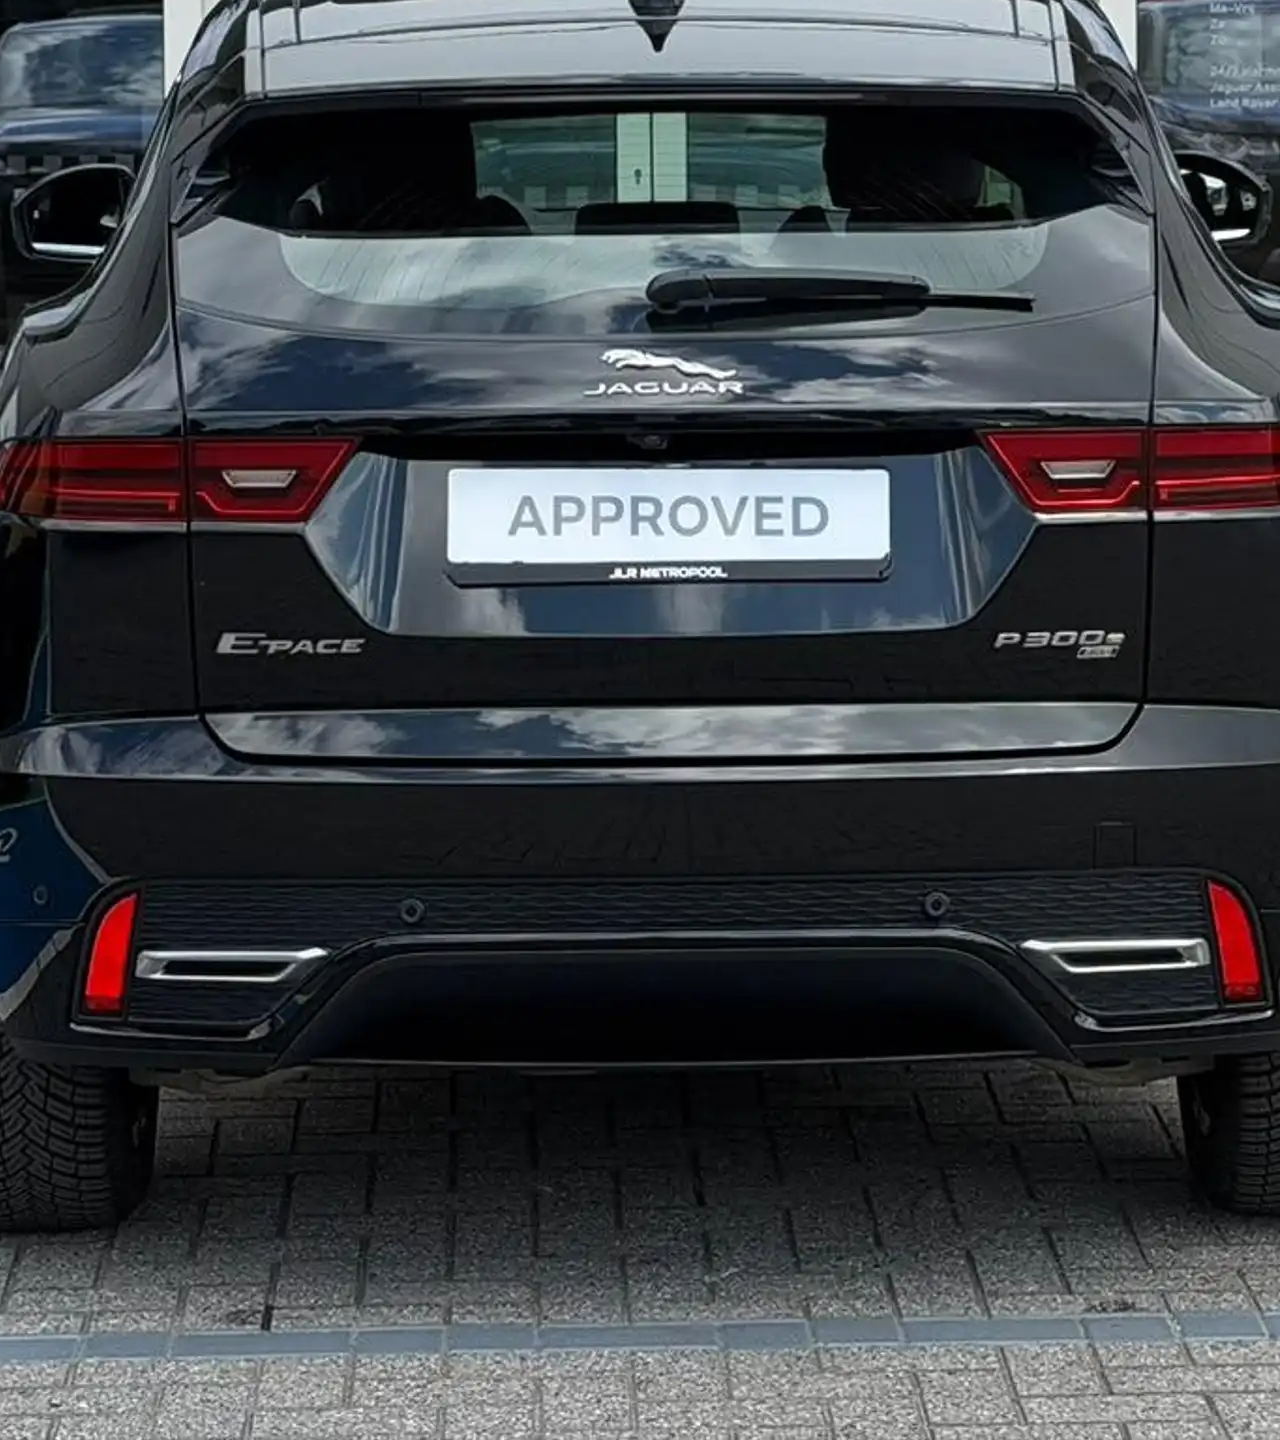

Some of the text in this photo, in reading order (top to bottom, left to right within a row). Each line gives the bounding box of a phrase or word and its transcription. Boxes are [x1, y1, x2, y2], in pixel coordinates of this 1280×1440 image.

[583, 381, 744, 396] JAGUAR
[507, 494, 830, 538] APPROVED
[609, 565, 728, 579] JLR METROPOOL
[993, 629, 1126, 649] P300e
